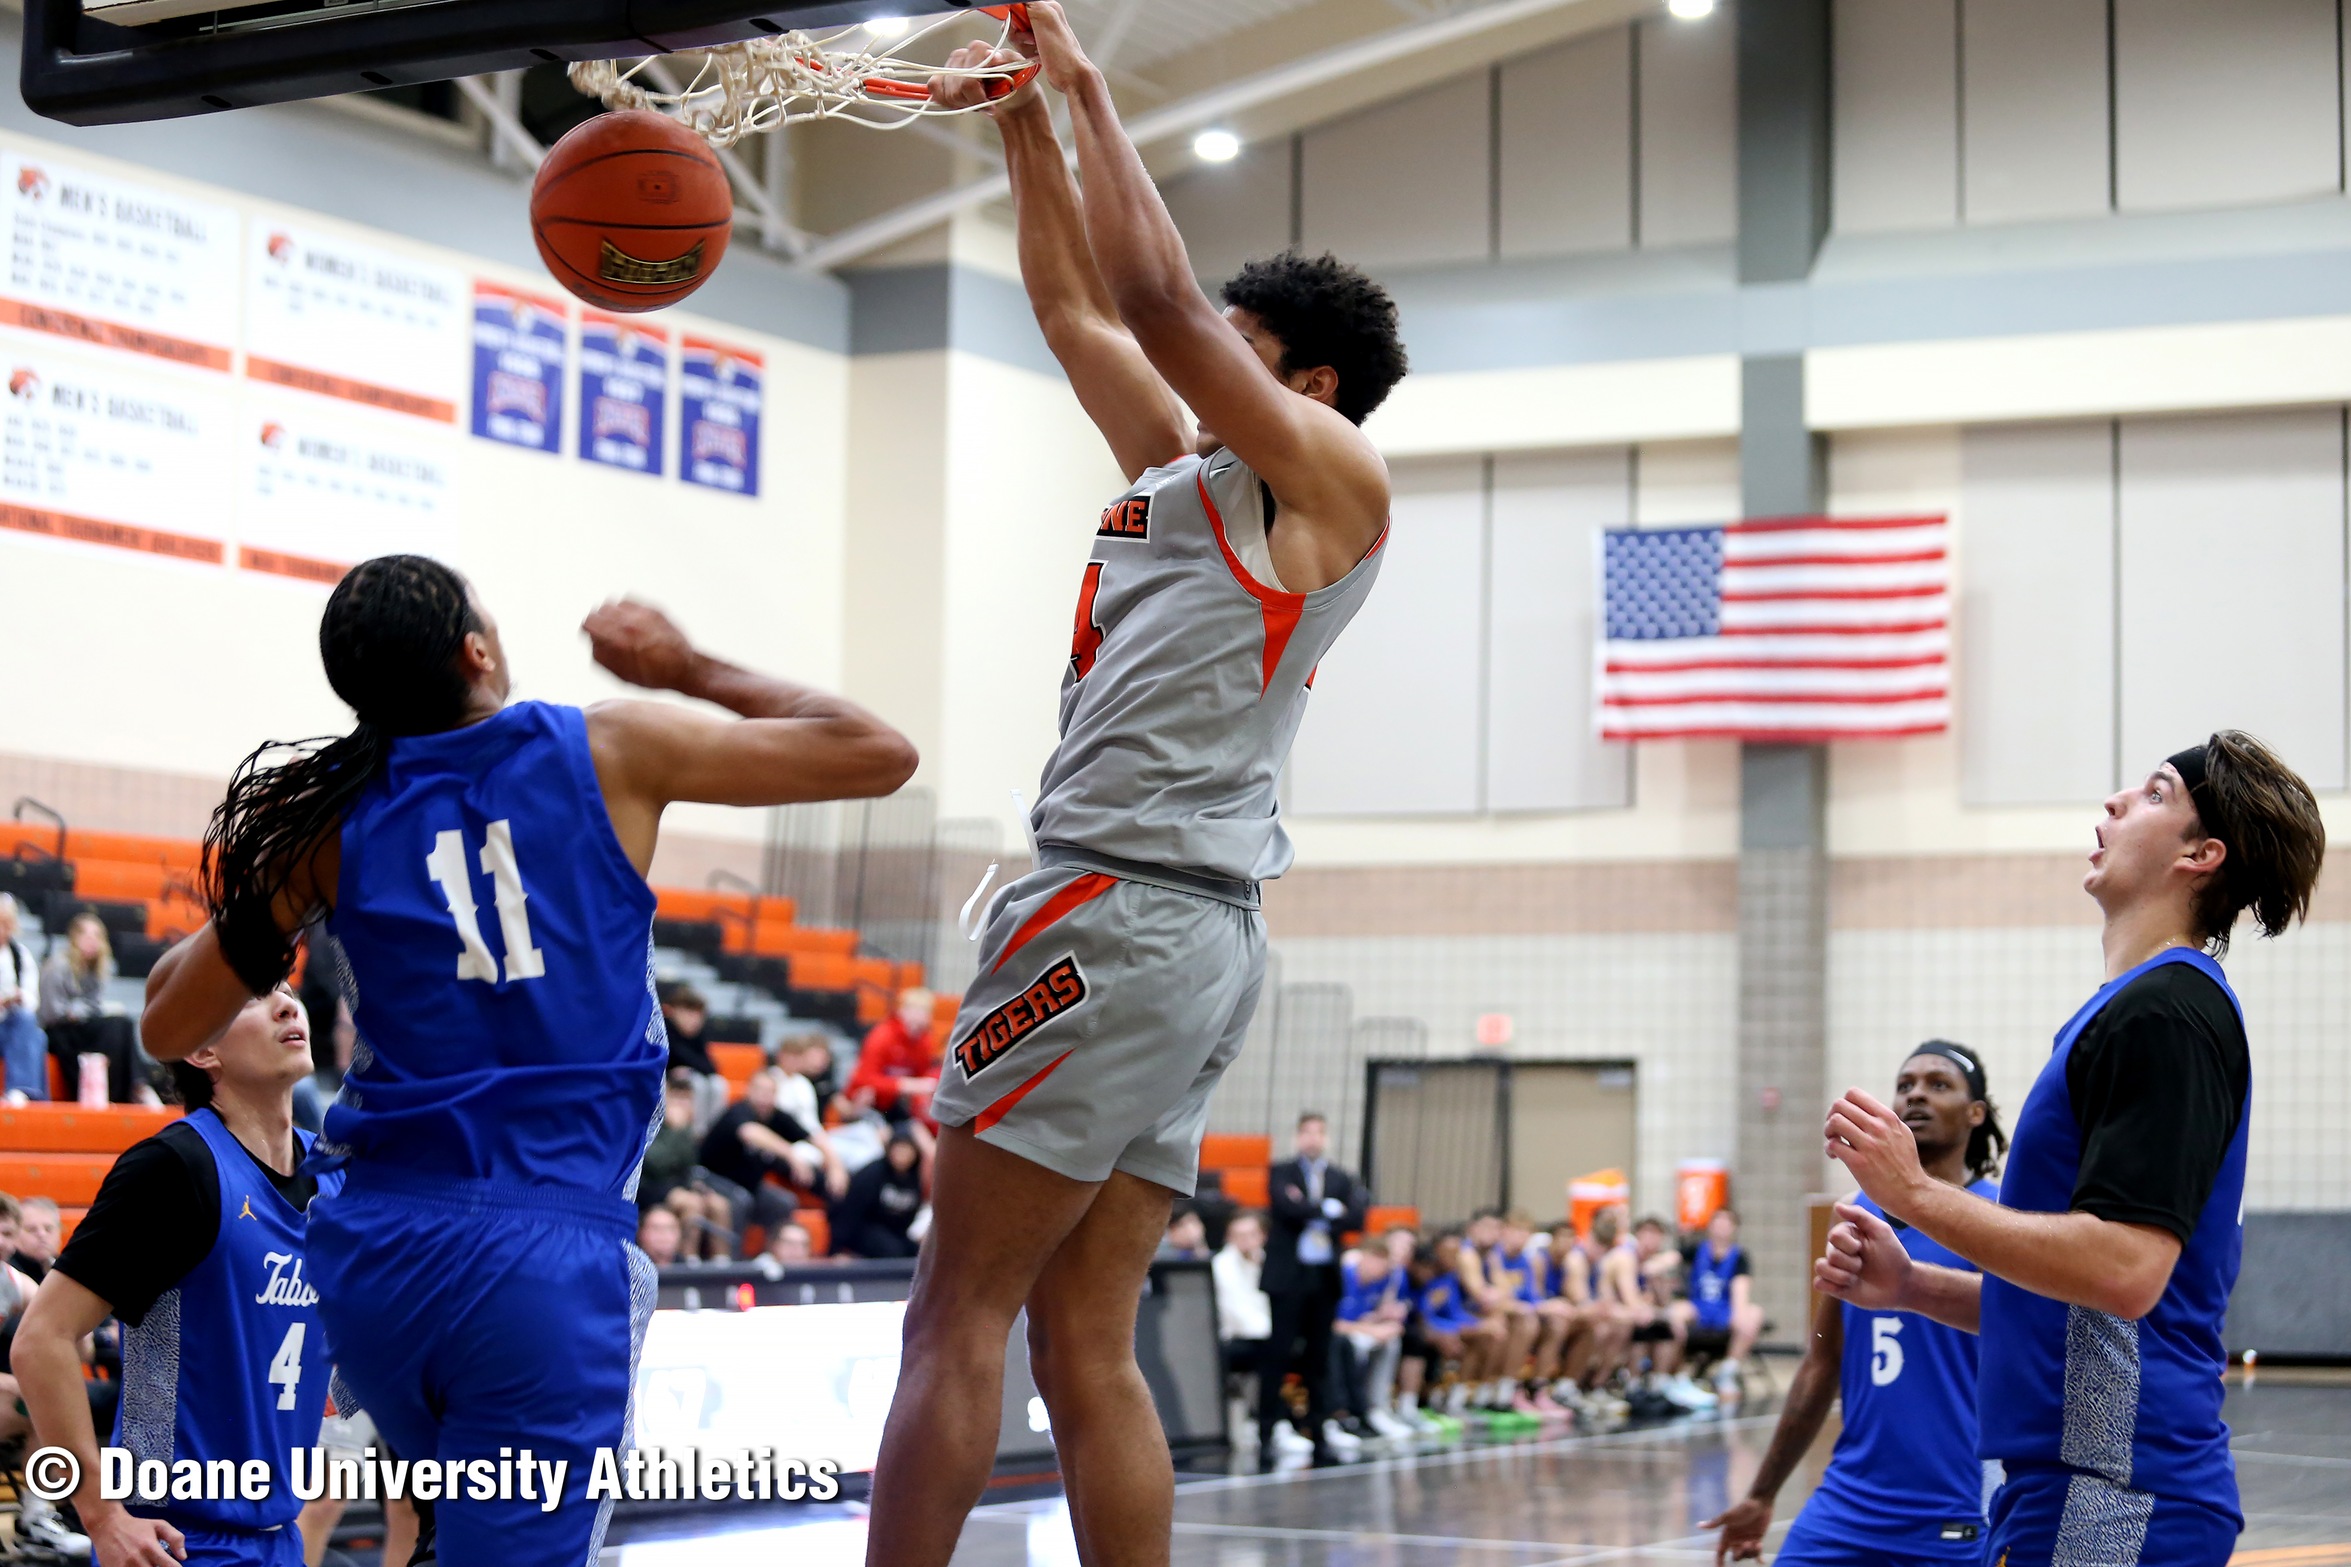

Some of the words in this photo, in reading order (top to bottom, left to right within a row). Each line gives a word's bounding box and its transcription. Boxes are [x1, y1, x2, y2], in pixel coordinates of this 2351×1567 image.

[426, 818, 546, 986] 11
[957, 964, 1081, 1072] TIGERS
[268, 1322, 306, 1411] 4
[1871, 1316, 1905, 1387] 5
